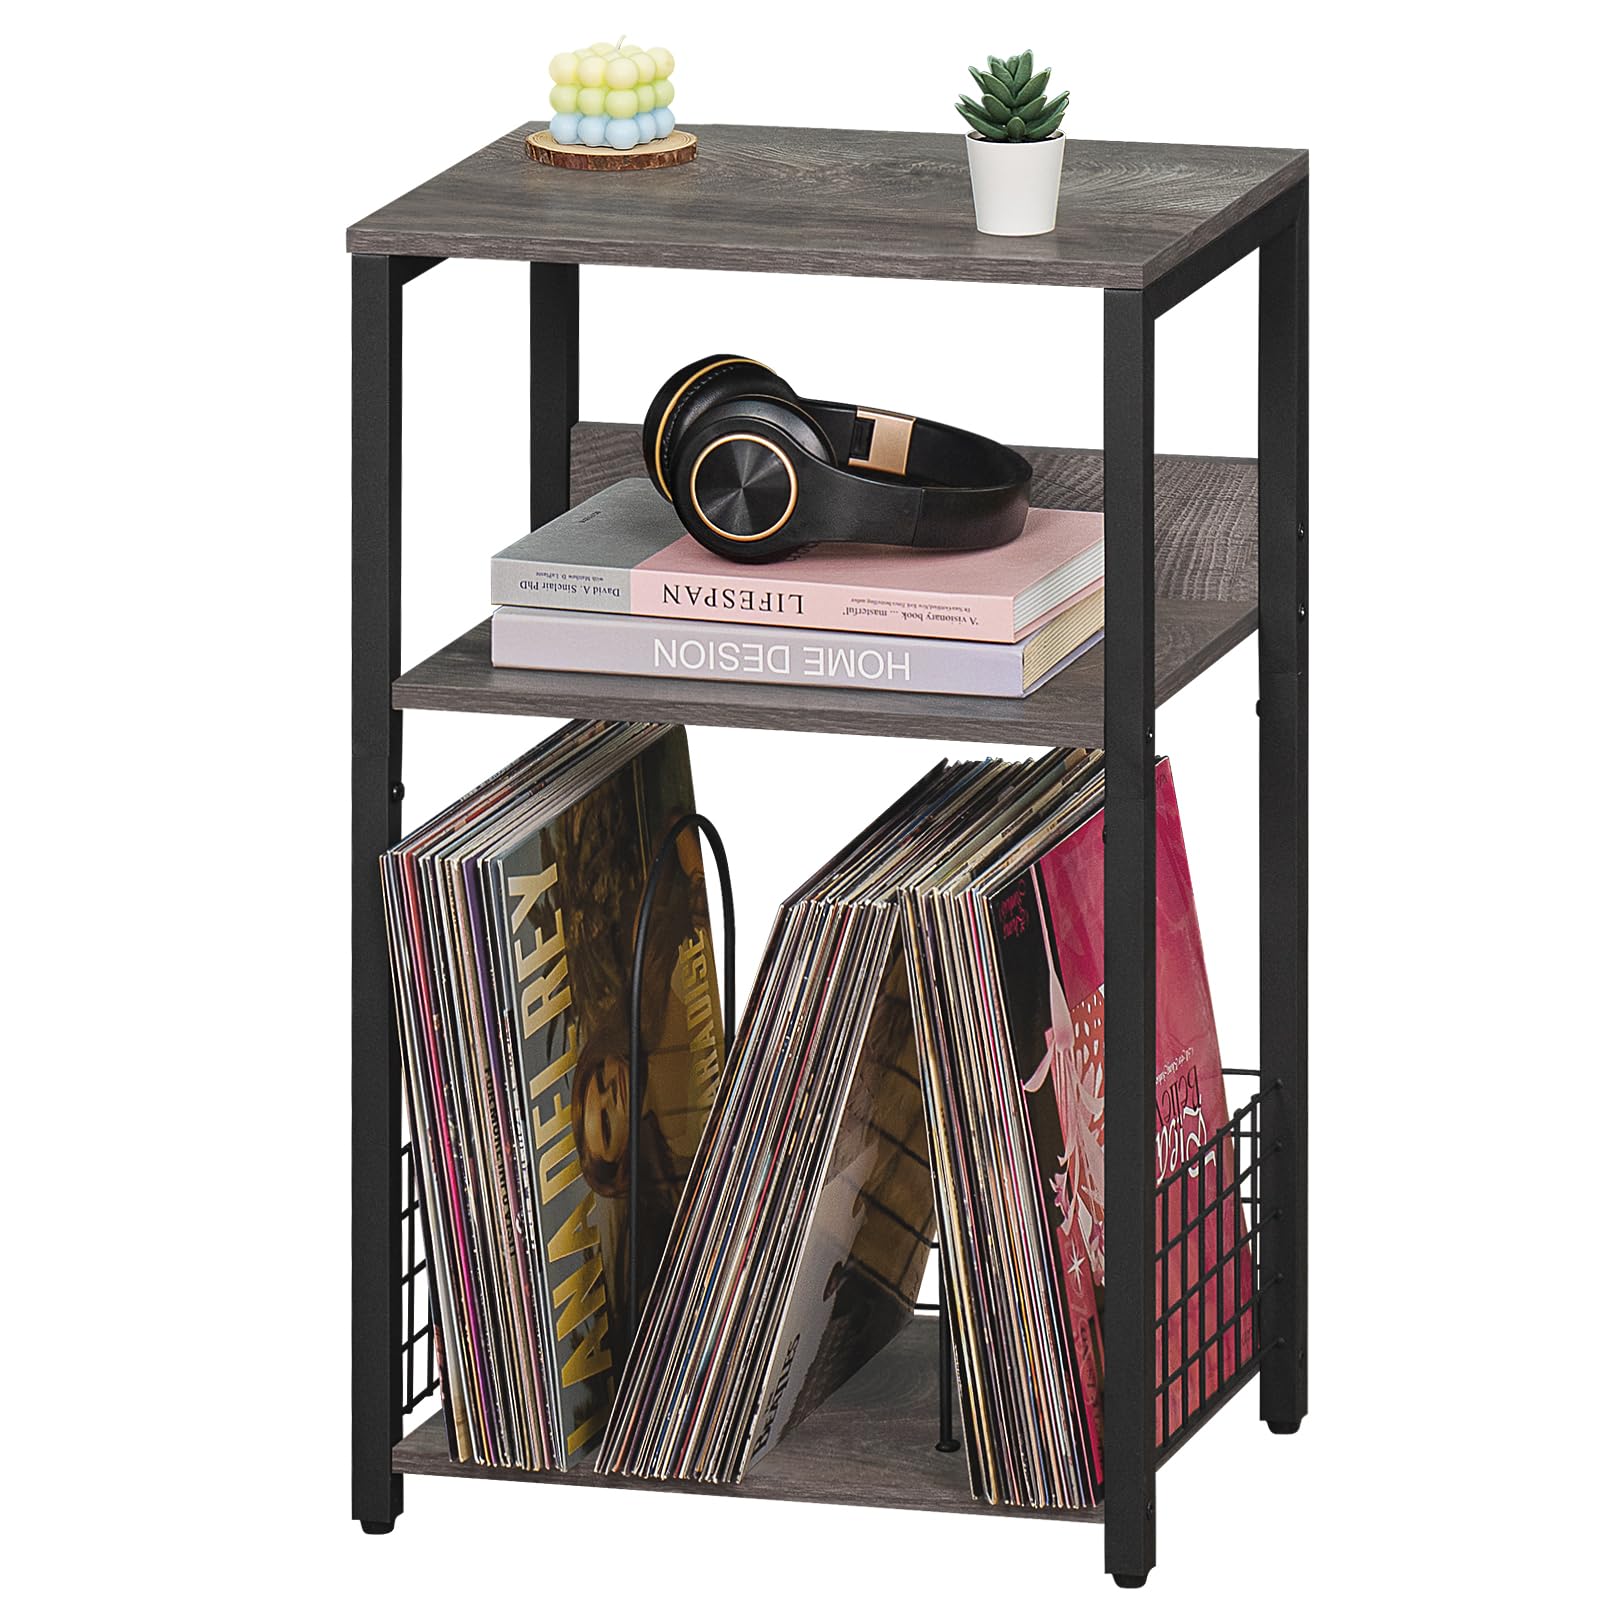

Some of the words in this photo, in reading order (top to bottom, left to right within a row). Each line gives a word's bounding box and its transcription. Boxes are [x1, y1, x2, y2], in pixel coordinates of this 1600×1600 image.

[519, 580, 539, 590] PhD
[542, 582, 577, 594] Sinclair
[580, 584, 591, 594] A.
[592, 586, 621, 598] David
[663, 583, 804, 615] LIFESPAN
[901, 611, 924, 622] book
[926, 612, 967, 624] visionary
[653, 638, 791, 675] DESION
[803, 645, 911, 681] HOME
[508, 860, 573, 1040] REY
[680, 927, 721, 1122] ARADISE
[547, 1191, 615, 1456] LANA
